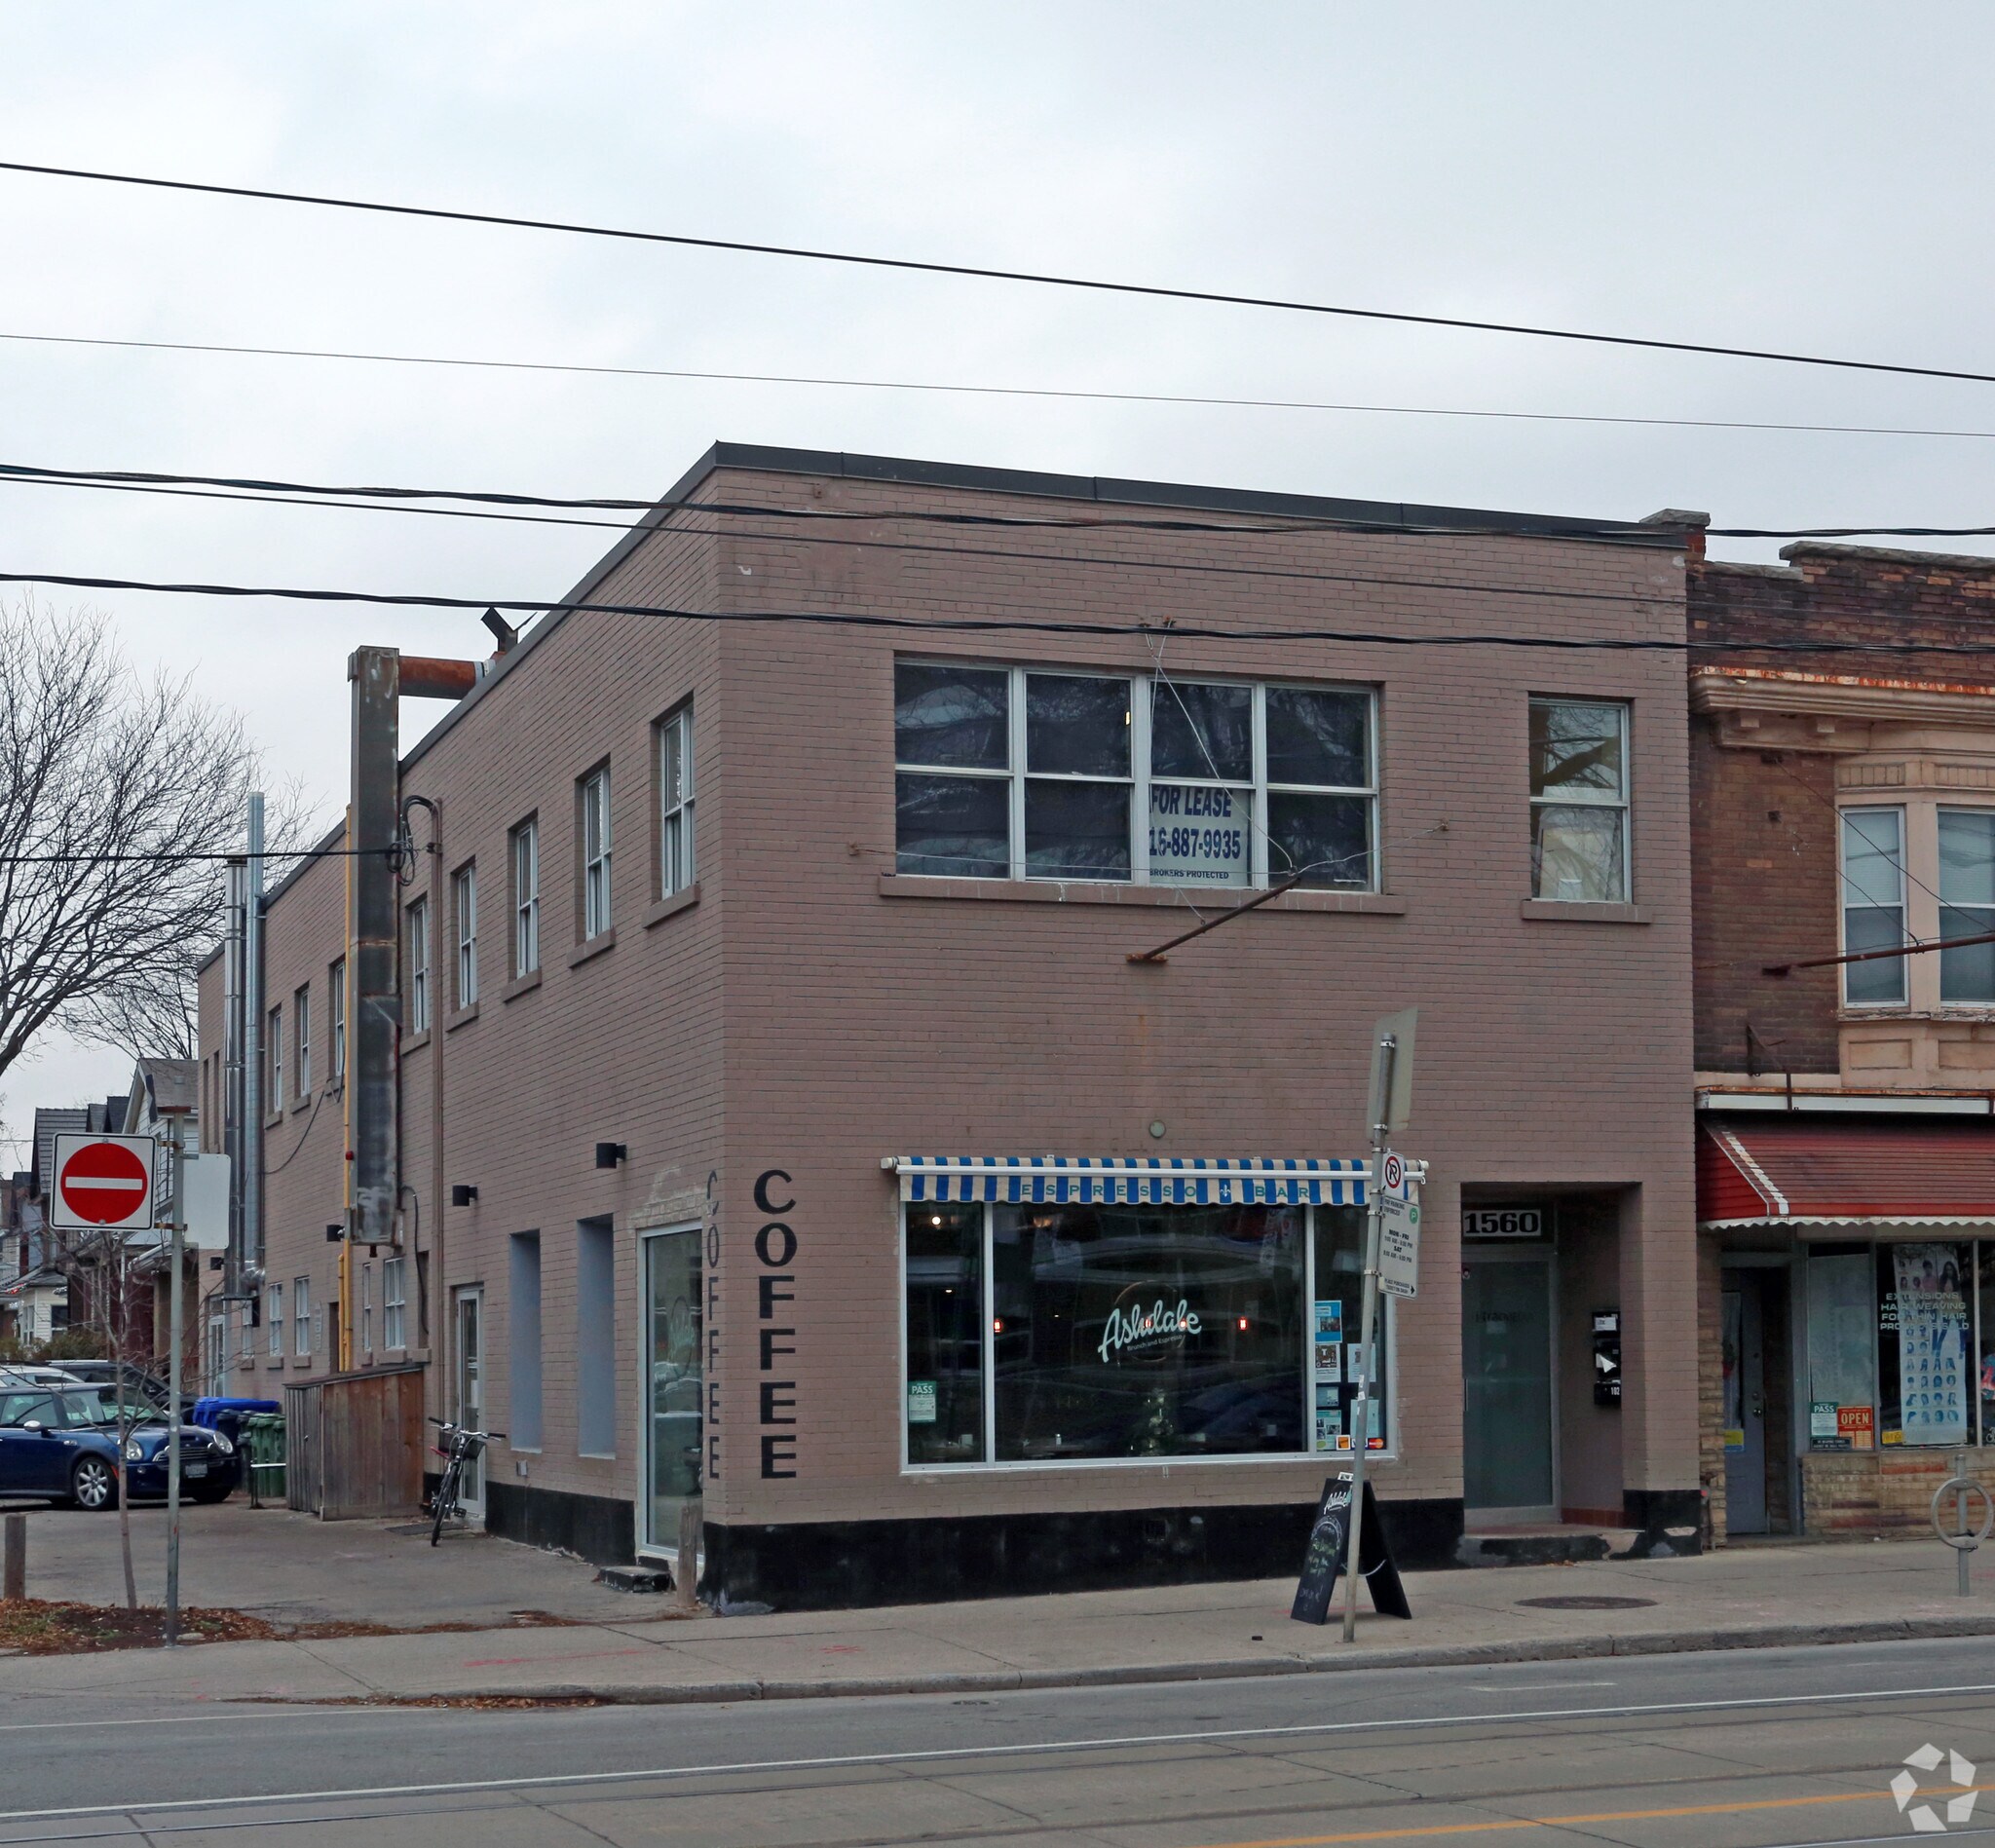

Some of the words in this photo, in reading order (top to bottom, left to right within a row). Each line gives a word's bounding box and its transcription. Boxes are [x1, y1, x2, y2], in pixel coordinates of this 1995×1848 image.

[1149, 786, 1180, 814] FOR
[1185, 787, 1232, 817] LEASE
[1149, 868, 1185, 877] BROKERS
[1186, 871, 1229, 880] PROTECTED
[1021, 1184, 1197, 1197] ESPRESSO
[1255, 1185, 1310, 1198] BAR
[1464, 1212, 1539, 1234] 1560
[1886, 1292, 1959, 1301] EXTENSIONS
[1881, 1302, 1908, 1311] HAIR
[1913, 1301, 1966, 1311] WEAVING
[1941, 1312, 1967, 1321] HAIR
[753, 1169, 797, 1480] COFFEE
[1941, 1322, 1970, 1331] SLD
[1098, 1299, 1202, 1363] Ashdale
[1127, 1342, 1148, 1352] Brunch
[1158, 1335, 1183, 1344] Espresso
[911, 1385, 933, 1394] PASS
[1814, 1405, 1835, 1414] PASS
[1841, 1413, 1869, 1425] OPEN
